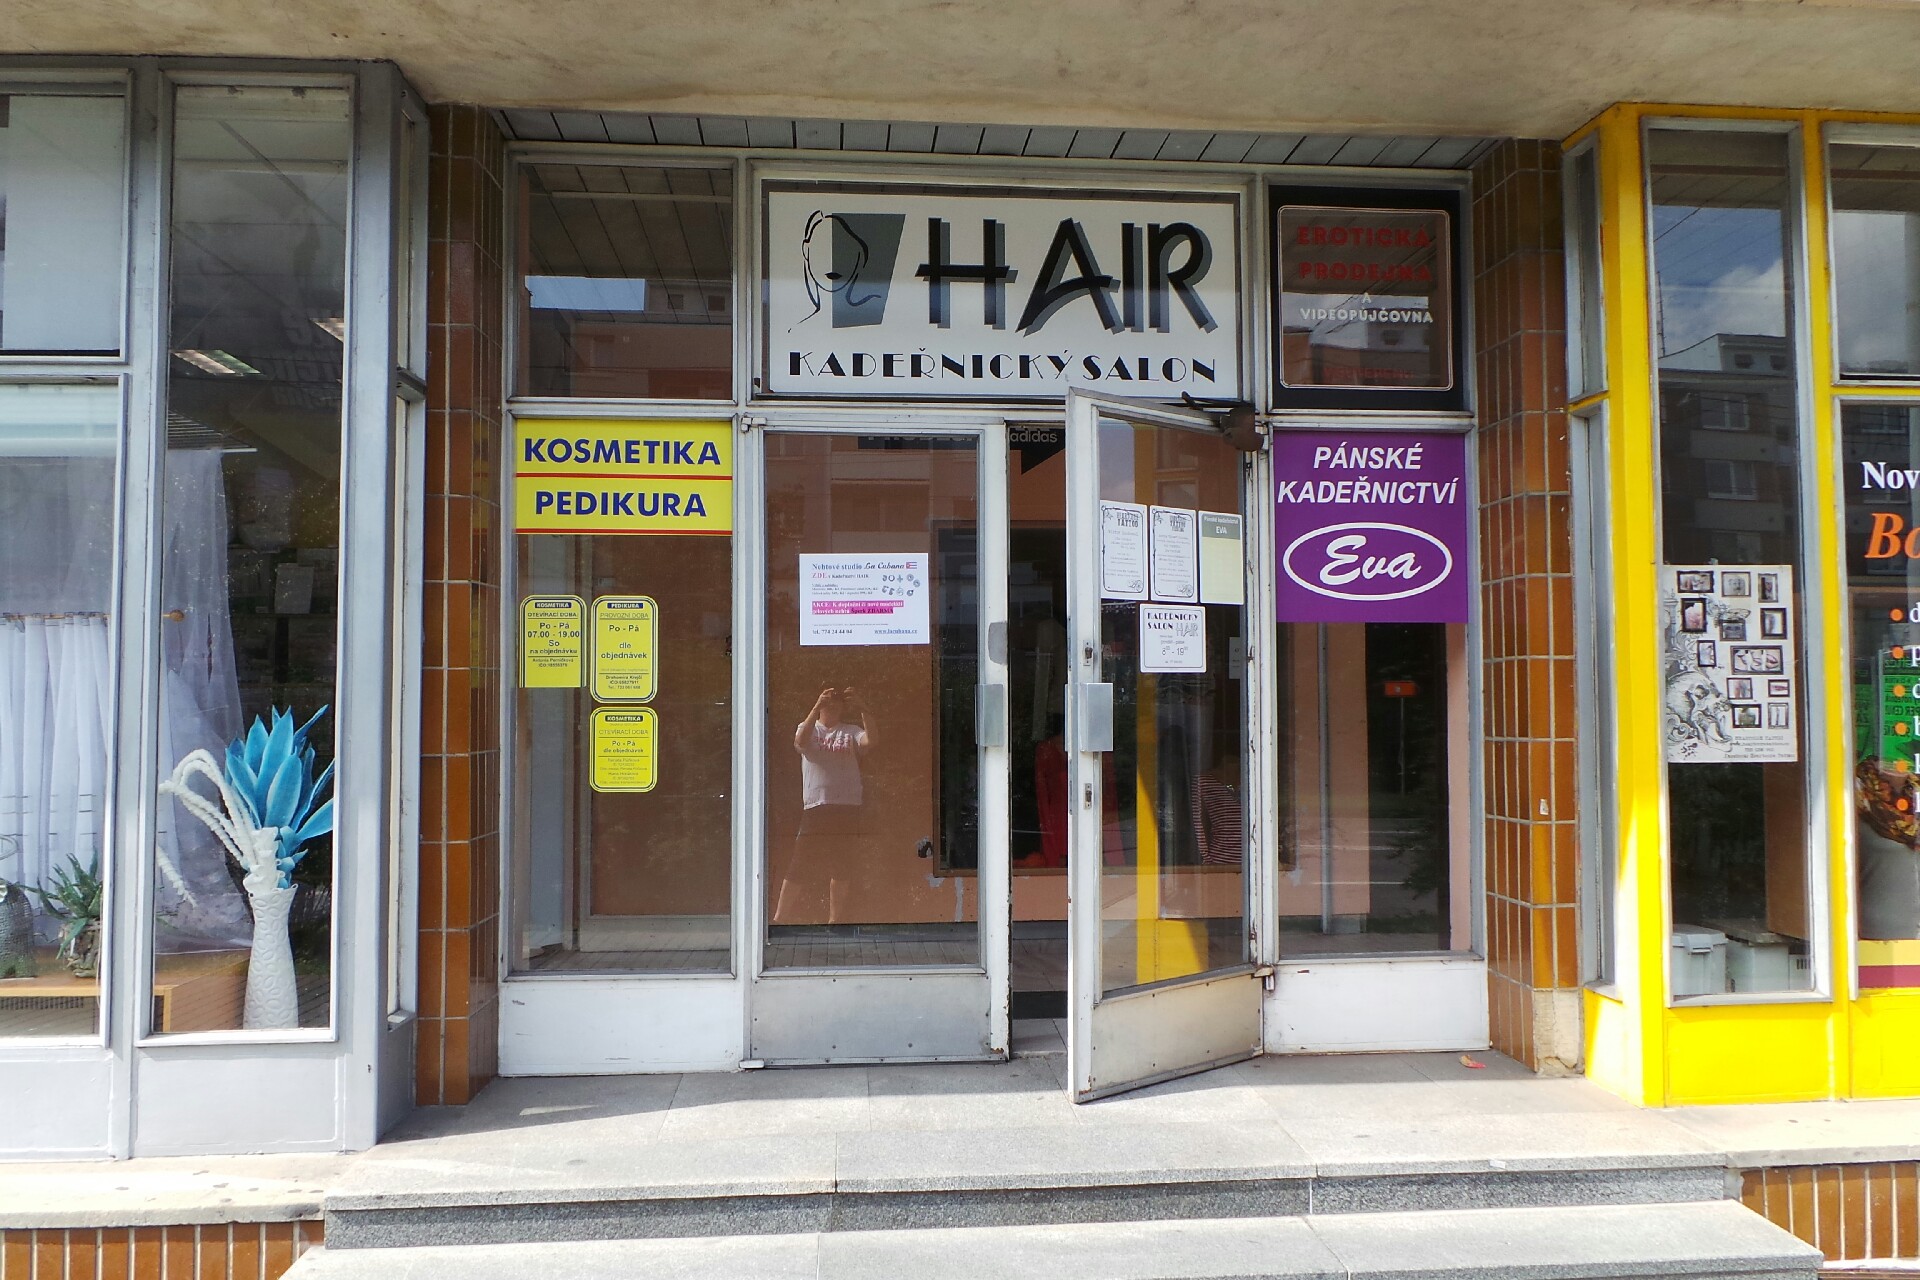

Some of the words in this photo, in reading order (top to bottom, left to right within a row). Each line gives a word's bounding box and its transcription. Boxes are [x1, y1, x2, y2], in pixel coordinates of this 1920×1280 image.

[1297, 224, 1430, 247] EROTICKÁ
[914, 216, 1219, 338] HAIR
[1300, 262, 1432, 281] PRODEJNA
[1362, 292, 1372, 304] A
[1300, 306, 1434, 324] VIDEOPŮJČOVNA
[789, 347, 1072, 382] KADEŘNICKÝ
[1082, 354, 1216, 384] SALON
[1010, 429, 1058, 442] adidas
[524, 438, 721, 466] KOSMETIKA
[1313, 442, 1423, 470] PÁNSKÉ
[1278, 476, 1459, 504] KADEŘNICTVÍ
[536, 490, 706, 517] PEDIKURA
[1216, 526, 1227, 534] EVA
[1319, 534, 1422, 586] Eva
[1176, 623, 1198, 637] HAIR
